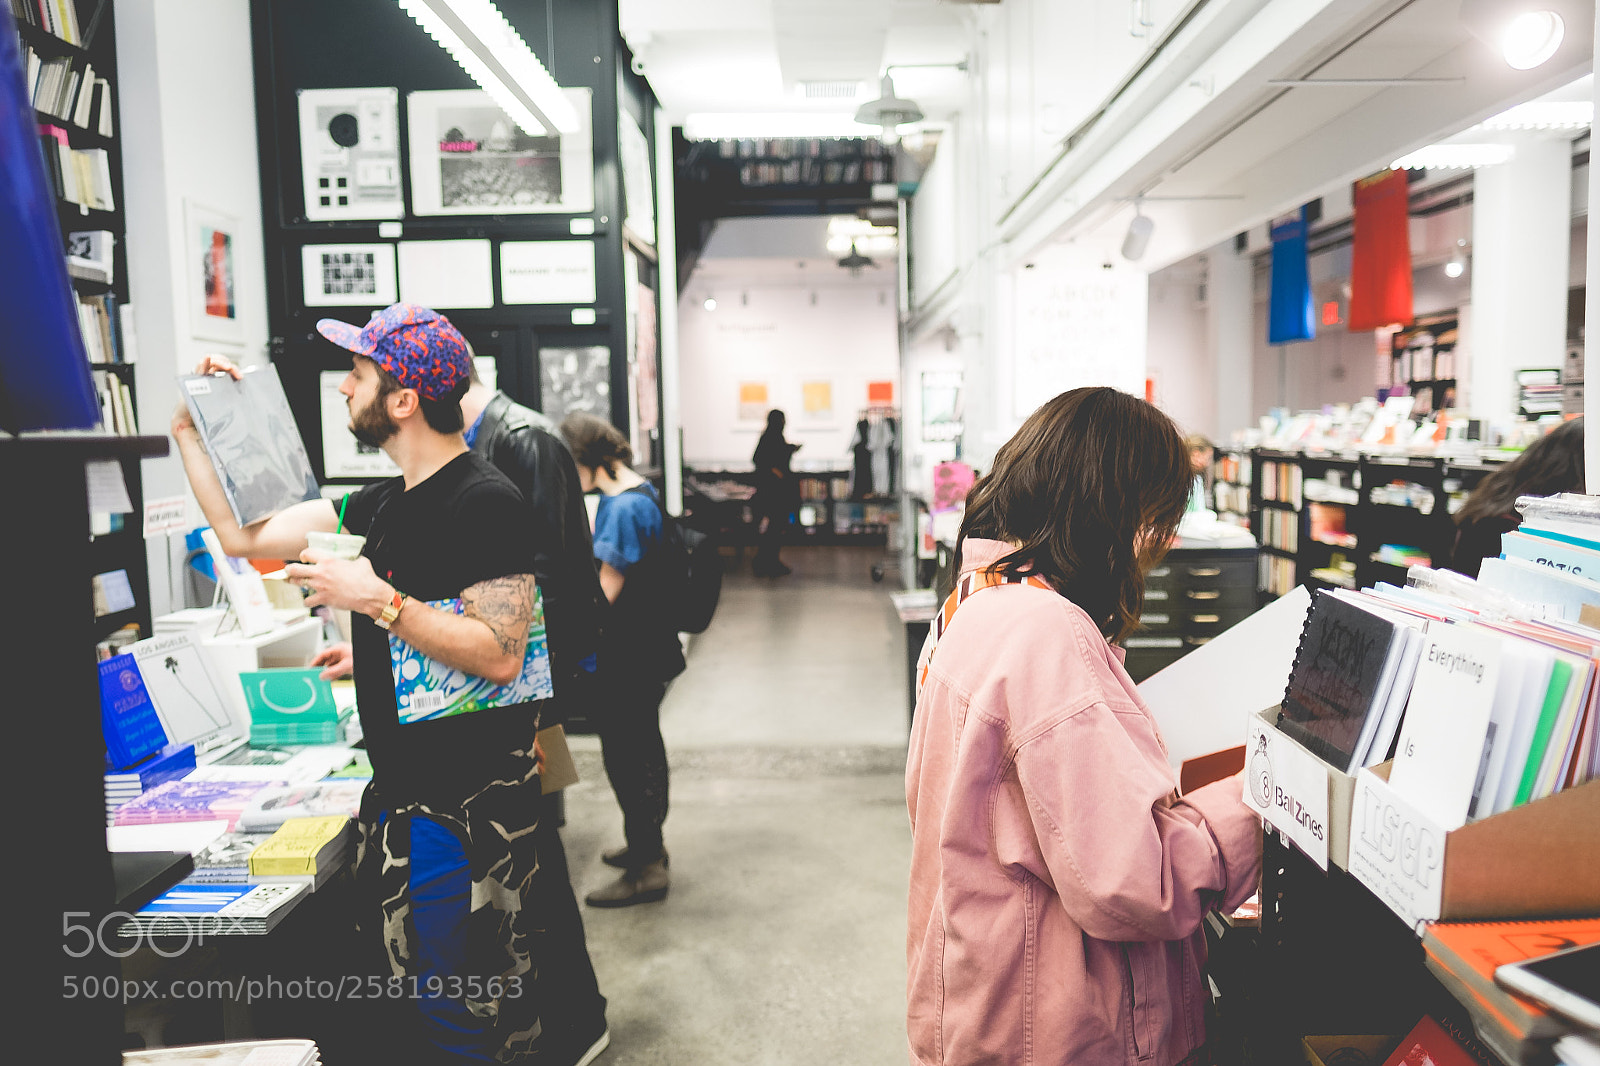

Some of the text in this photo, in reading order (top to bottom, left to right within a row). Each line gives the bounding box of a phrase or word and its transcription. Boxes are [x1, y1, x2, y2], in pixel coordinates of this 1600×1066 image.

[1428, 643, 1485, 684] Everything
[1404, 736, 1415, 757] Is
[1275, 785, 1295, 818] Ball
[1295, 800, 1324, 842] Zines
